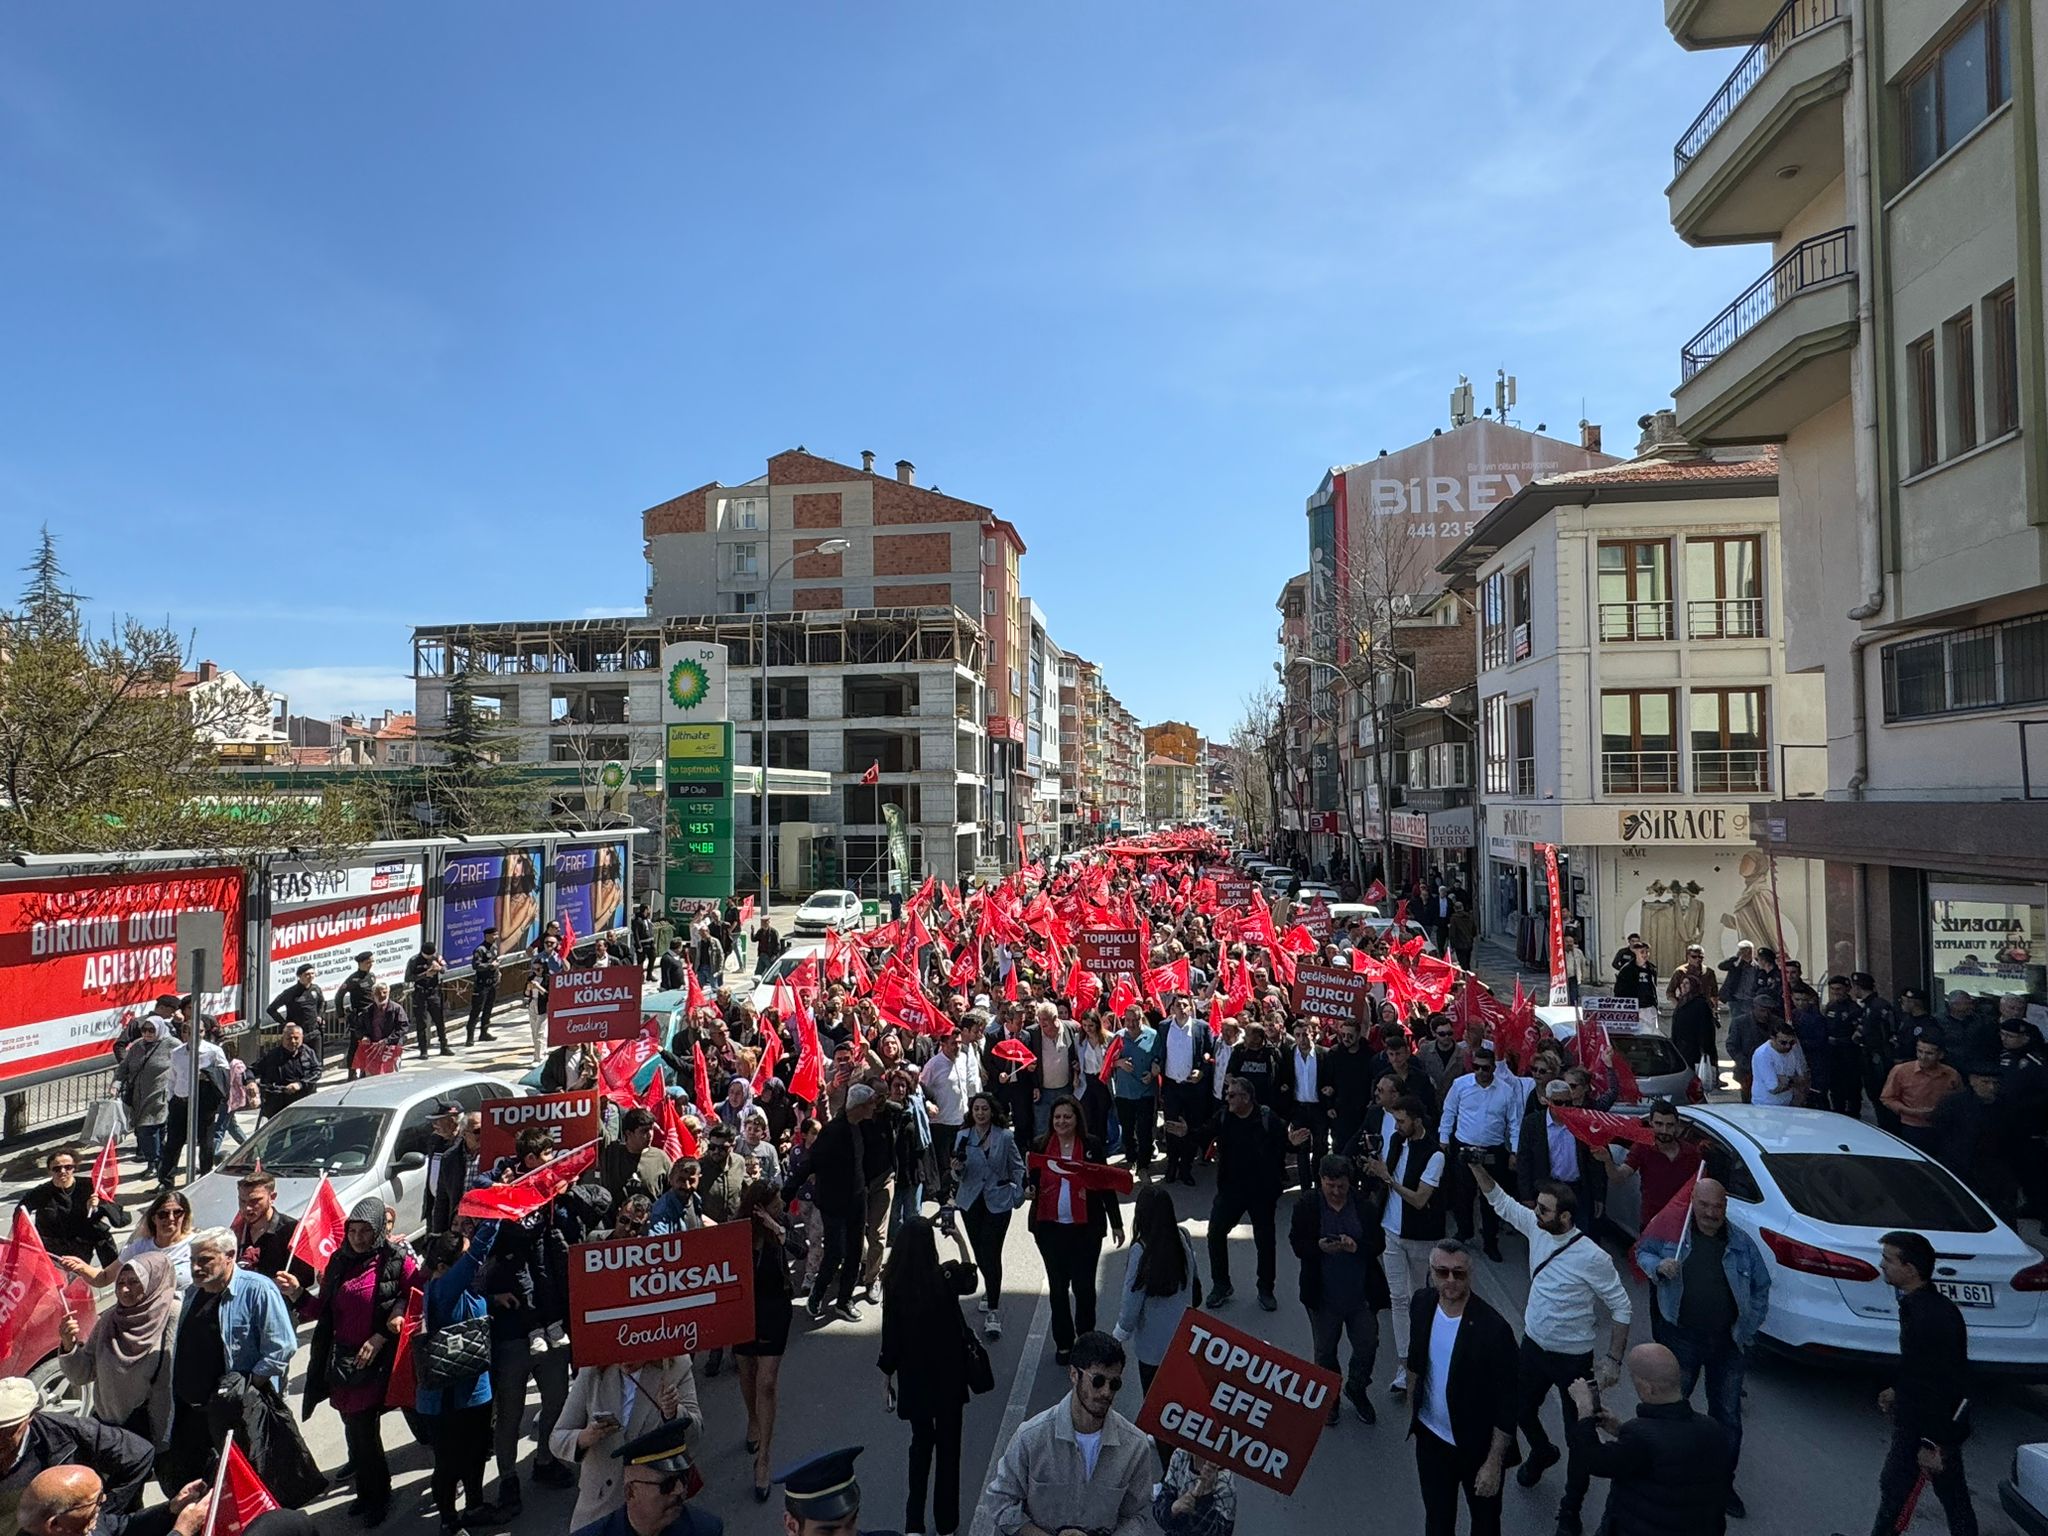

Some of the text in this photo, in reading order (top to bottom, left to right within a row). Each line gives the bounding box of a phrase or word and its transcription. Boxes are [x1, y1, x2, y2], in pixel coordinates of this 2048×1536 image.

[1371, 472, 1558, 516] BİREV
[1407, 521, 1474, 538] 444 23 5
[700, 649, 714, 661] bp
[690, 786, 707, 794] Club
[1430, 824, 1471, 835] TUĞRA
[1639, 809, 1726, 839] SİRACE
[1433, 836, 1469, 845] PERDE
[32, 914, 119, 956] BİRİKİM
[271, 907, 367, 949] MANTOLAMA
[1083, 933, 1136, 943] TOPUKLU
[1099, 946, 1120, 956] EFE
[82, 946, 174, 994] AÇILIYOR
[1086, 959, 1135, 968] GELİYOR
[555, 971, 604, 989] BURCU
[1300, 971, 1362, 988] DEĞİŞİMİN ADI
[574, 986, 633, 1004] KÖKSAL
[1306, 985, 1354, 1003] BURCU
[1301, 999, 1356, 1018] KÖKSAL
[1583, 1011, 1637, 1021] KRALIK
[566, 1016, 608, 1038] loading
[490, 1098, 591, 1126] TOPUKLU
[585, 1239, 682, 1273] BURCU
[629, 1261, 738, 1298] KÖKSAL
[1963, 1286, 1988, 1301] 661
[1188, 1324, 1327, 1410] TOPUKLU
[1210, 1381, 1273, 1429] EFE
[1159, 1402, 1289, 1480] GELİYOR
